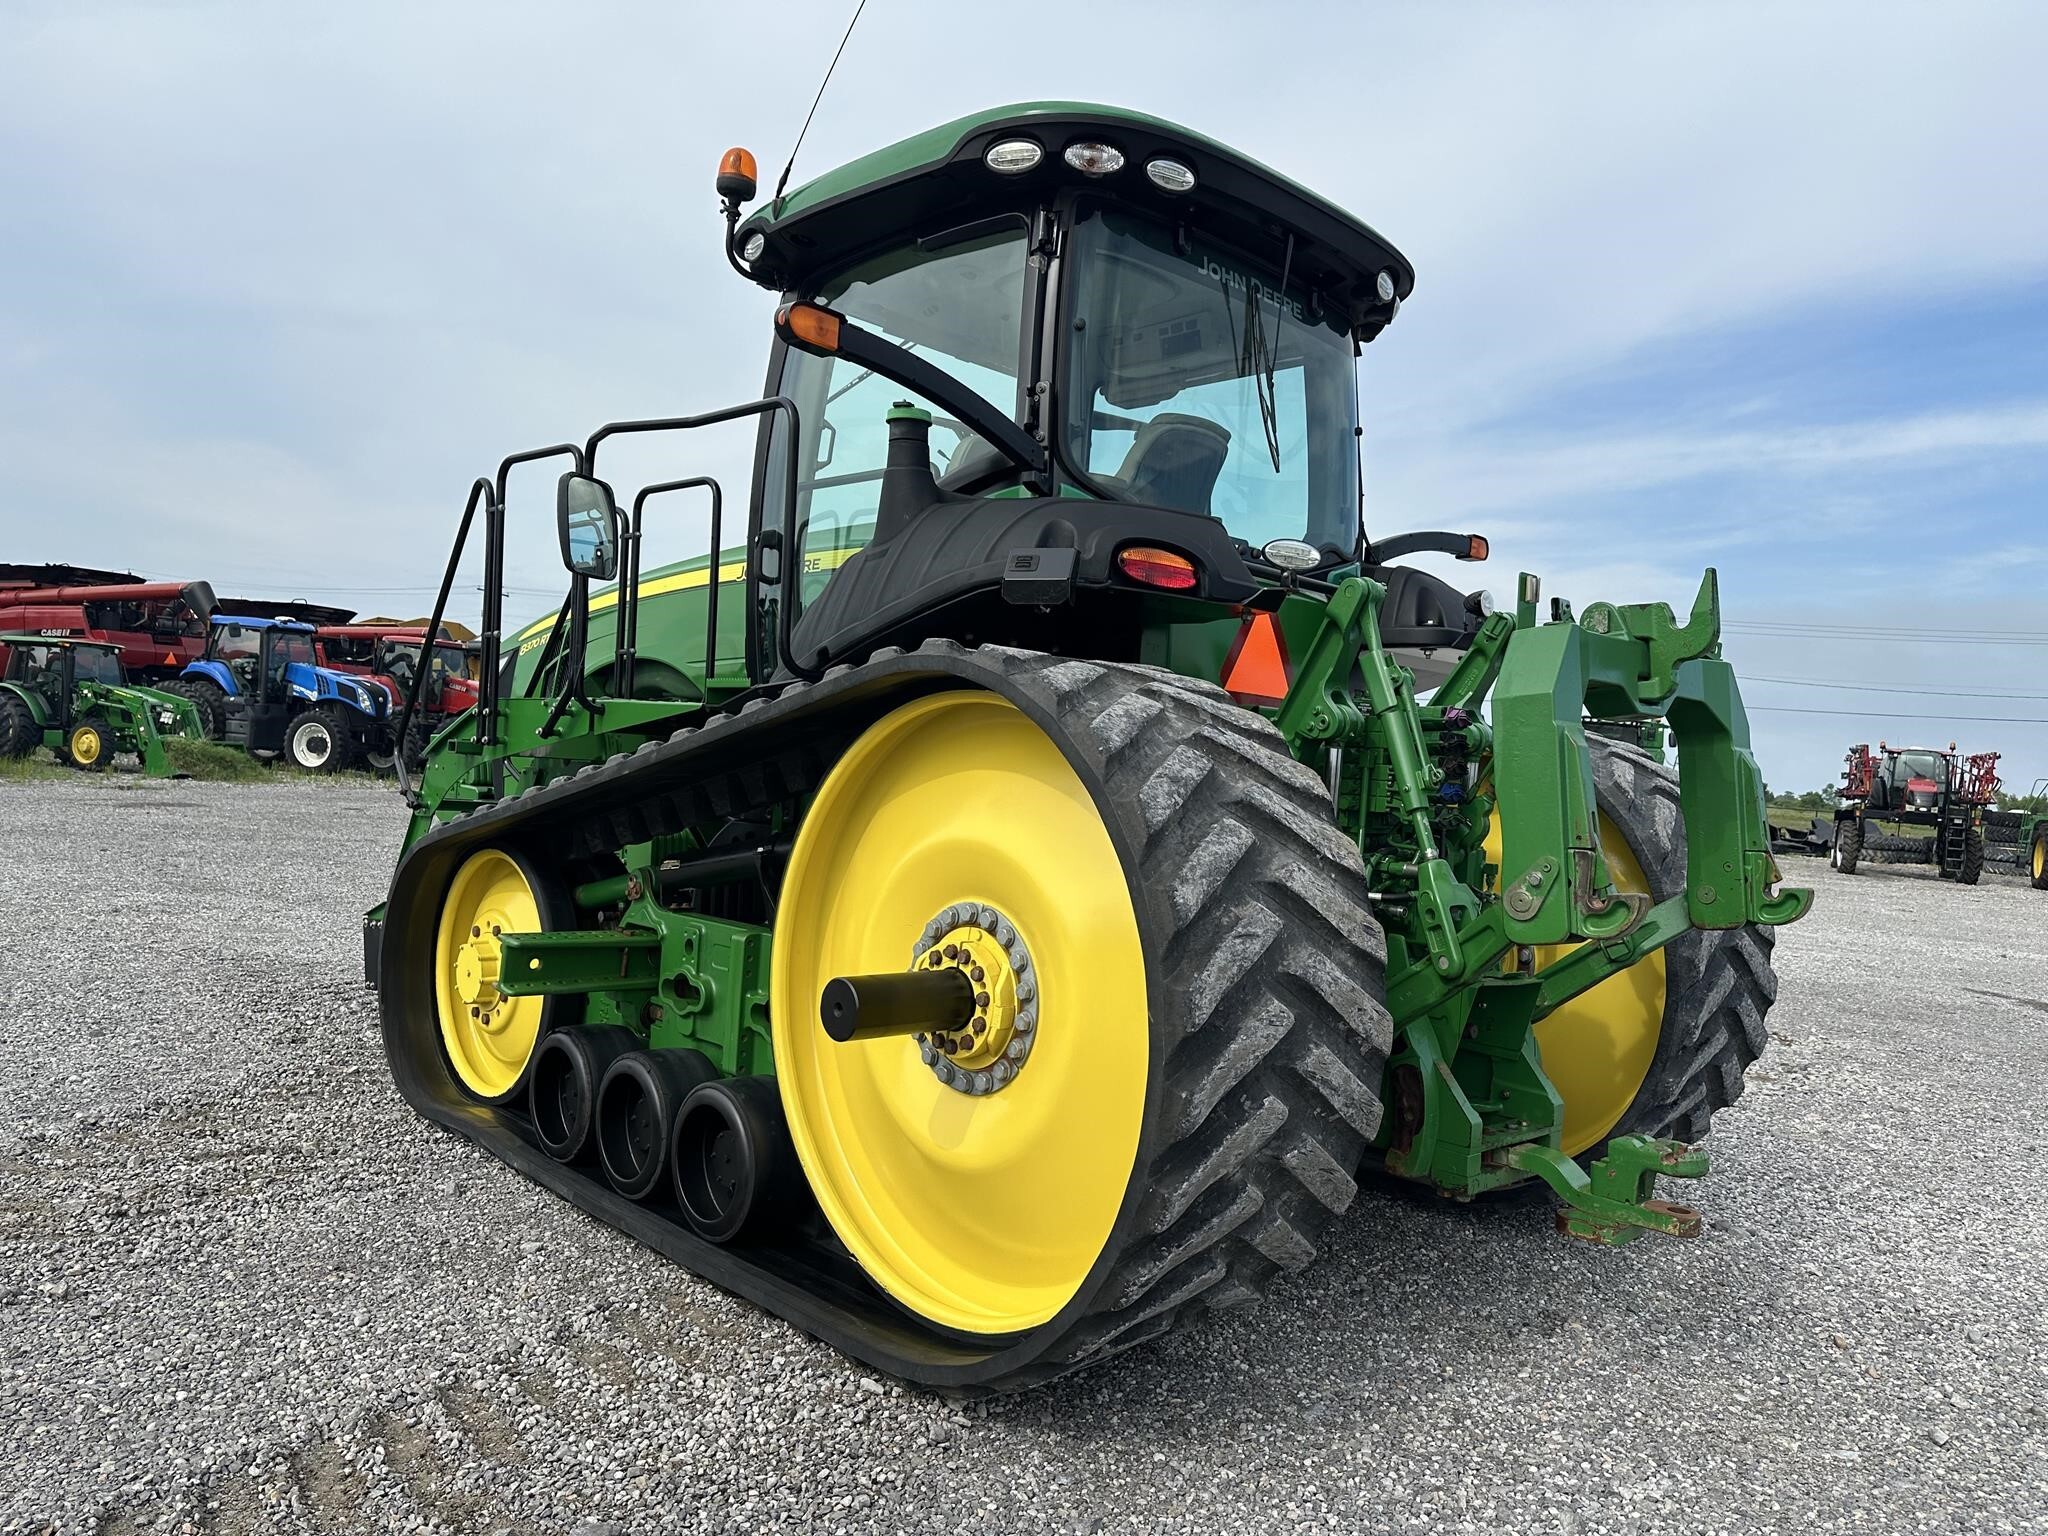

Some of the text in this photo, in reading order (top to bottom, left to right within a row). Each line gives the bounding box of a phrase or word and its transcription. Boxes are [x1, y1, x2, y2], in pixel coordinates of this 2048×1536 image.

[1198, 256, 1303, 320] JOHN DEERE
[40, 628, 62, 637] CASE
[520, 637, 541, 656] 8370
